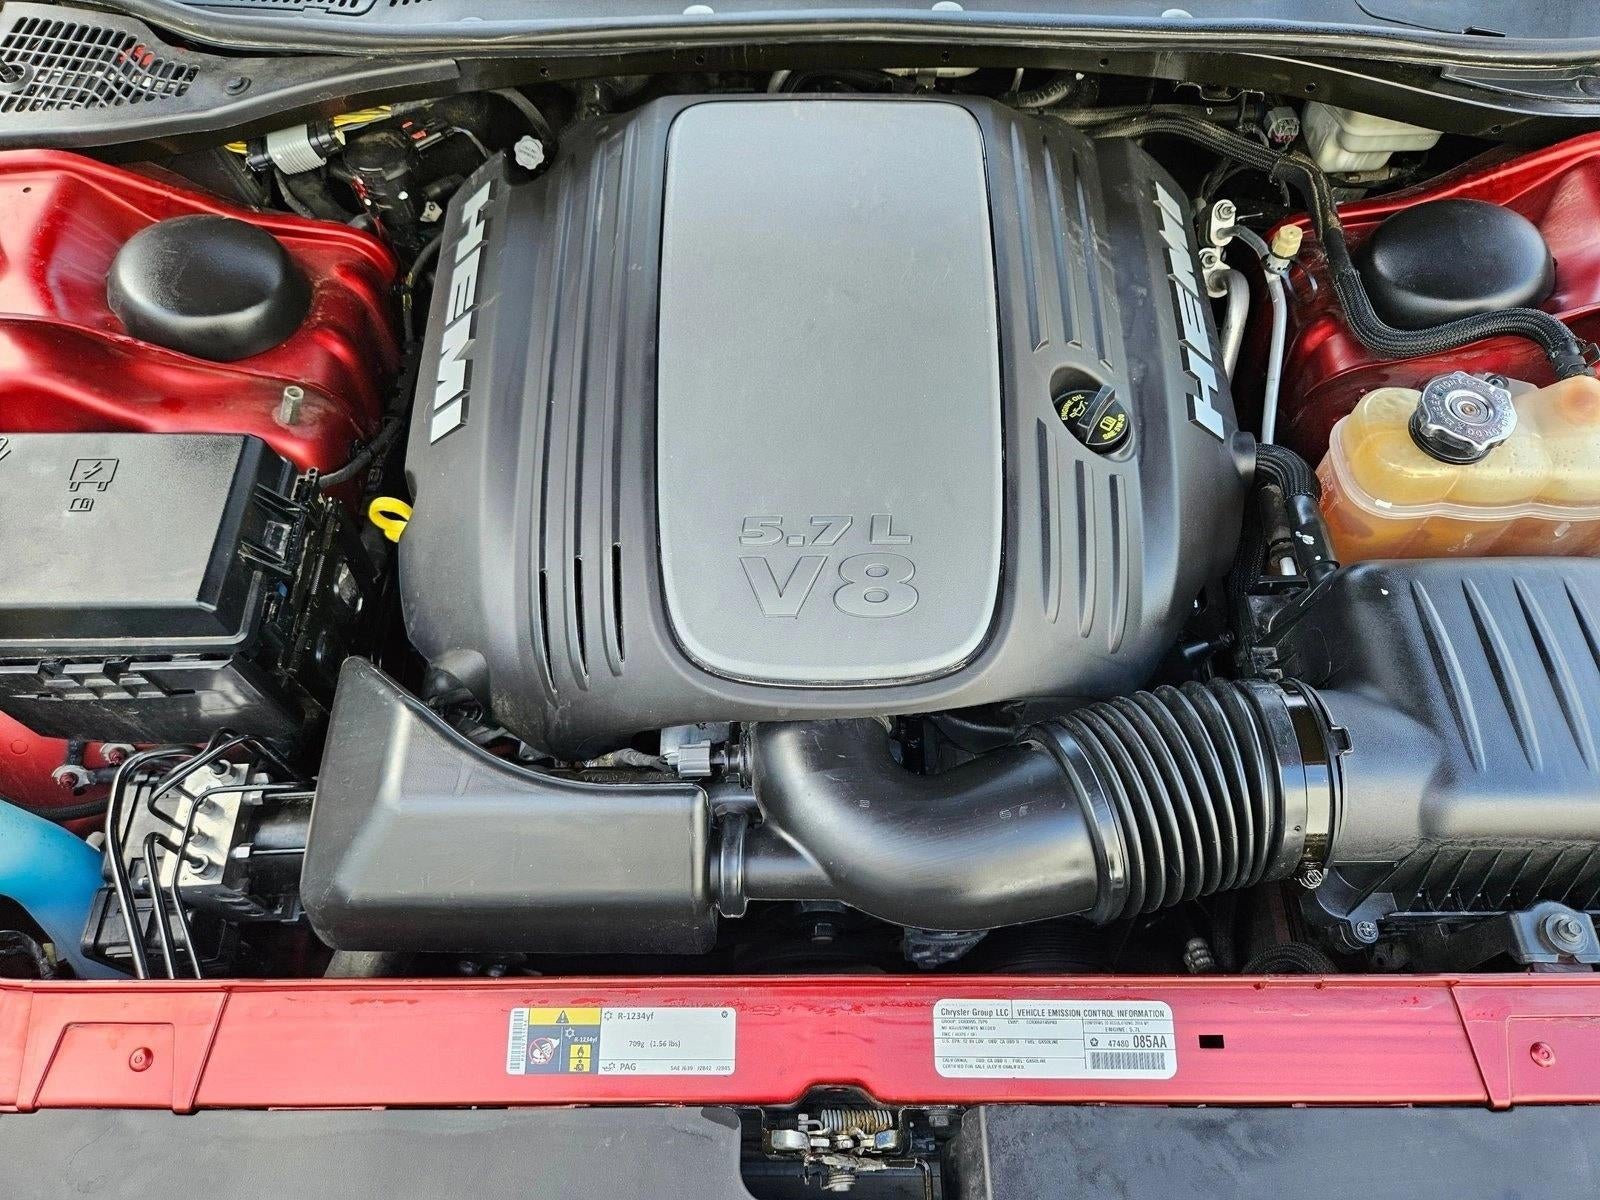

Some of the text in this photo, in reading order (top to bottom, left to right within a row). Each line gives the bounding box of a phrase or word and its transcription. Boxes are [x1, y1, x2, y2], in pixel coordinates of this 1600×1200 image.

[430, 181, 491, 445] HEMI
[1154, 181, 1225, 443] HEMI
[1061, 394, 1084, 420] ENGINE OIL
[739, 552, 920, 618] V8
[617, 1011, 654, 1022] R-1234yf
[940, 1008, 1009, 1017] Chrysler Group LLC
[1017, 1009, 1165, 1018] VEHICLE EMISSION CONTROL INFORMATION
[629, 1040, 681, 1049] 709g (1.56 lbs)
[1133, 1035, 1167, 1048] 085AA
[619, 1063, 637, 1071] PAG
